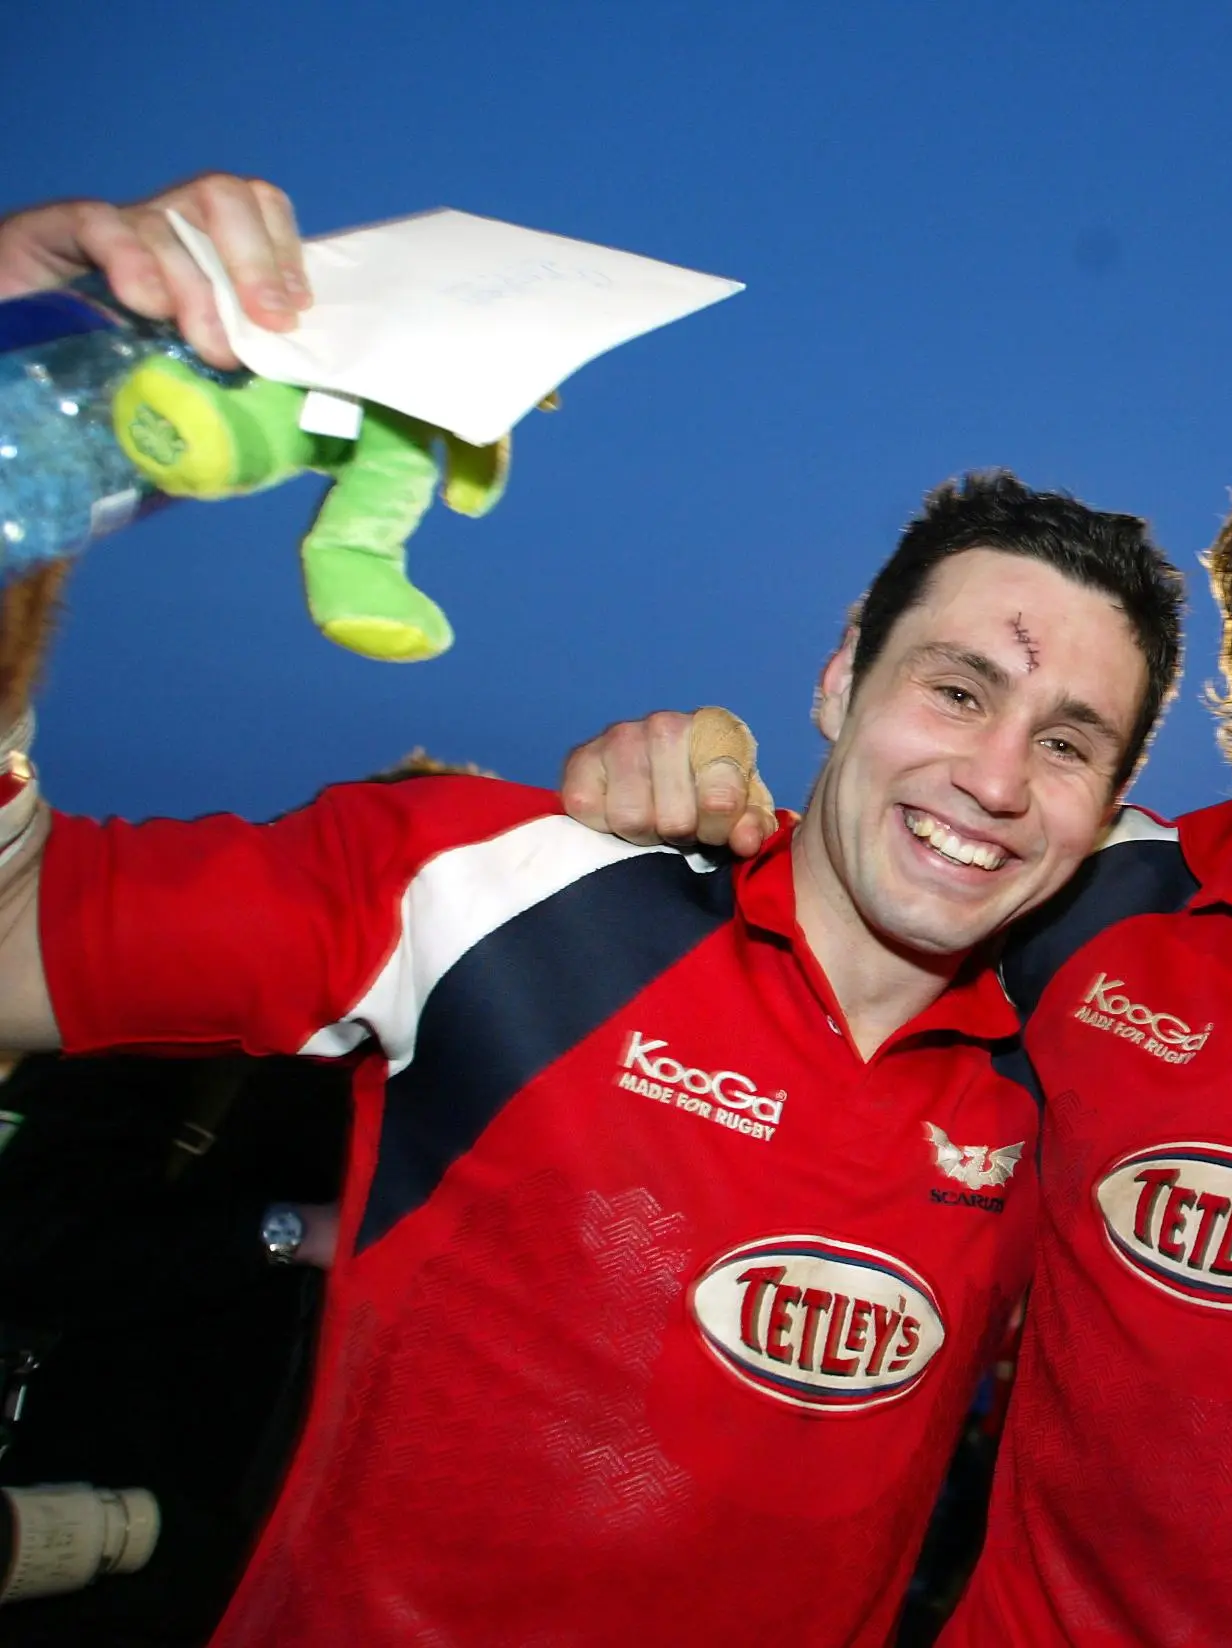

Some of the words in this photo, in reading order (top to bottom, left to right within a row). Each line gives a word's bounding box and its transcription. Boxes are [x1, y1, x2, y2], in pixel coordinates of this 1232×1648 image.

[1074, 1005, 1115, 1031] MADE
[1113, 1021, 1146, 1045] FOR
[1083, 972, 1211, 1051] KooGa
[617, 1031, 785, 1124] KooGa
[617, 1072, 674, 1104] MADE
[675, 1094, 714, 1119] FOR
[714, 1108, 776, 1142] RUGBY
